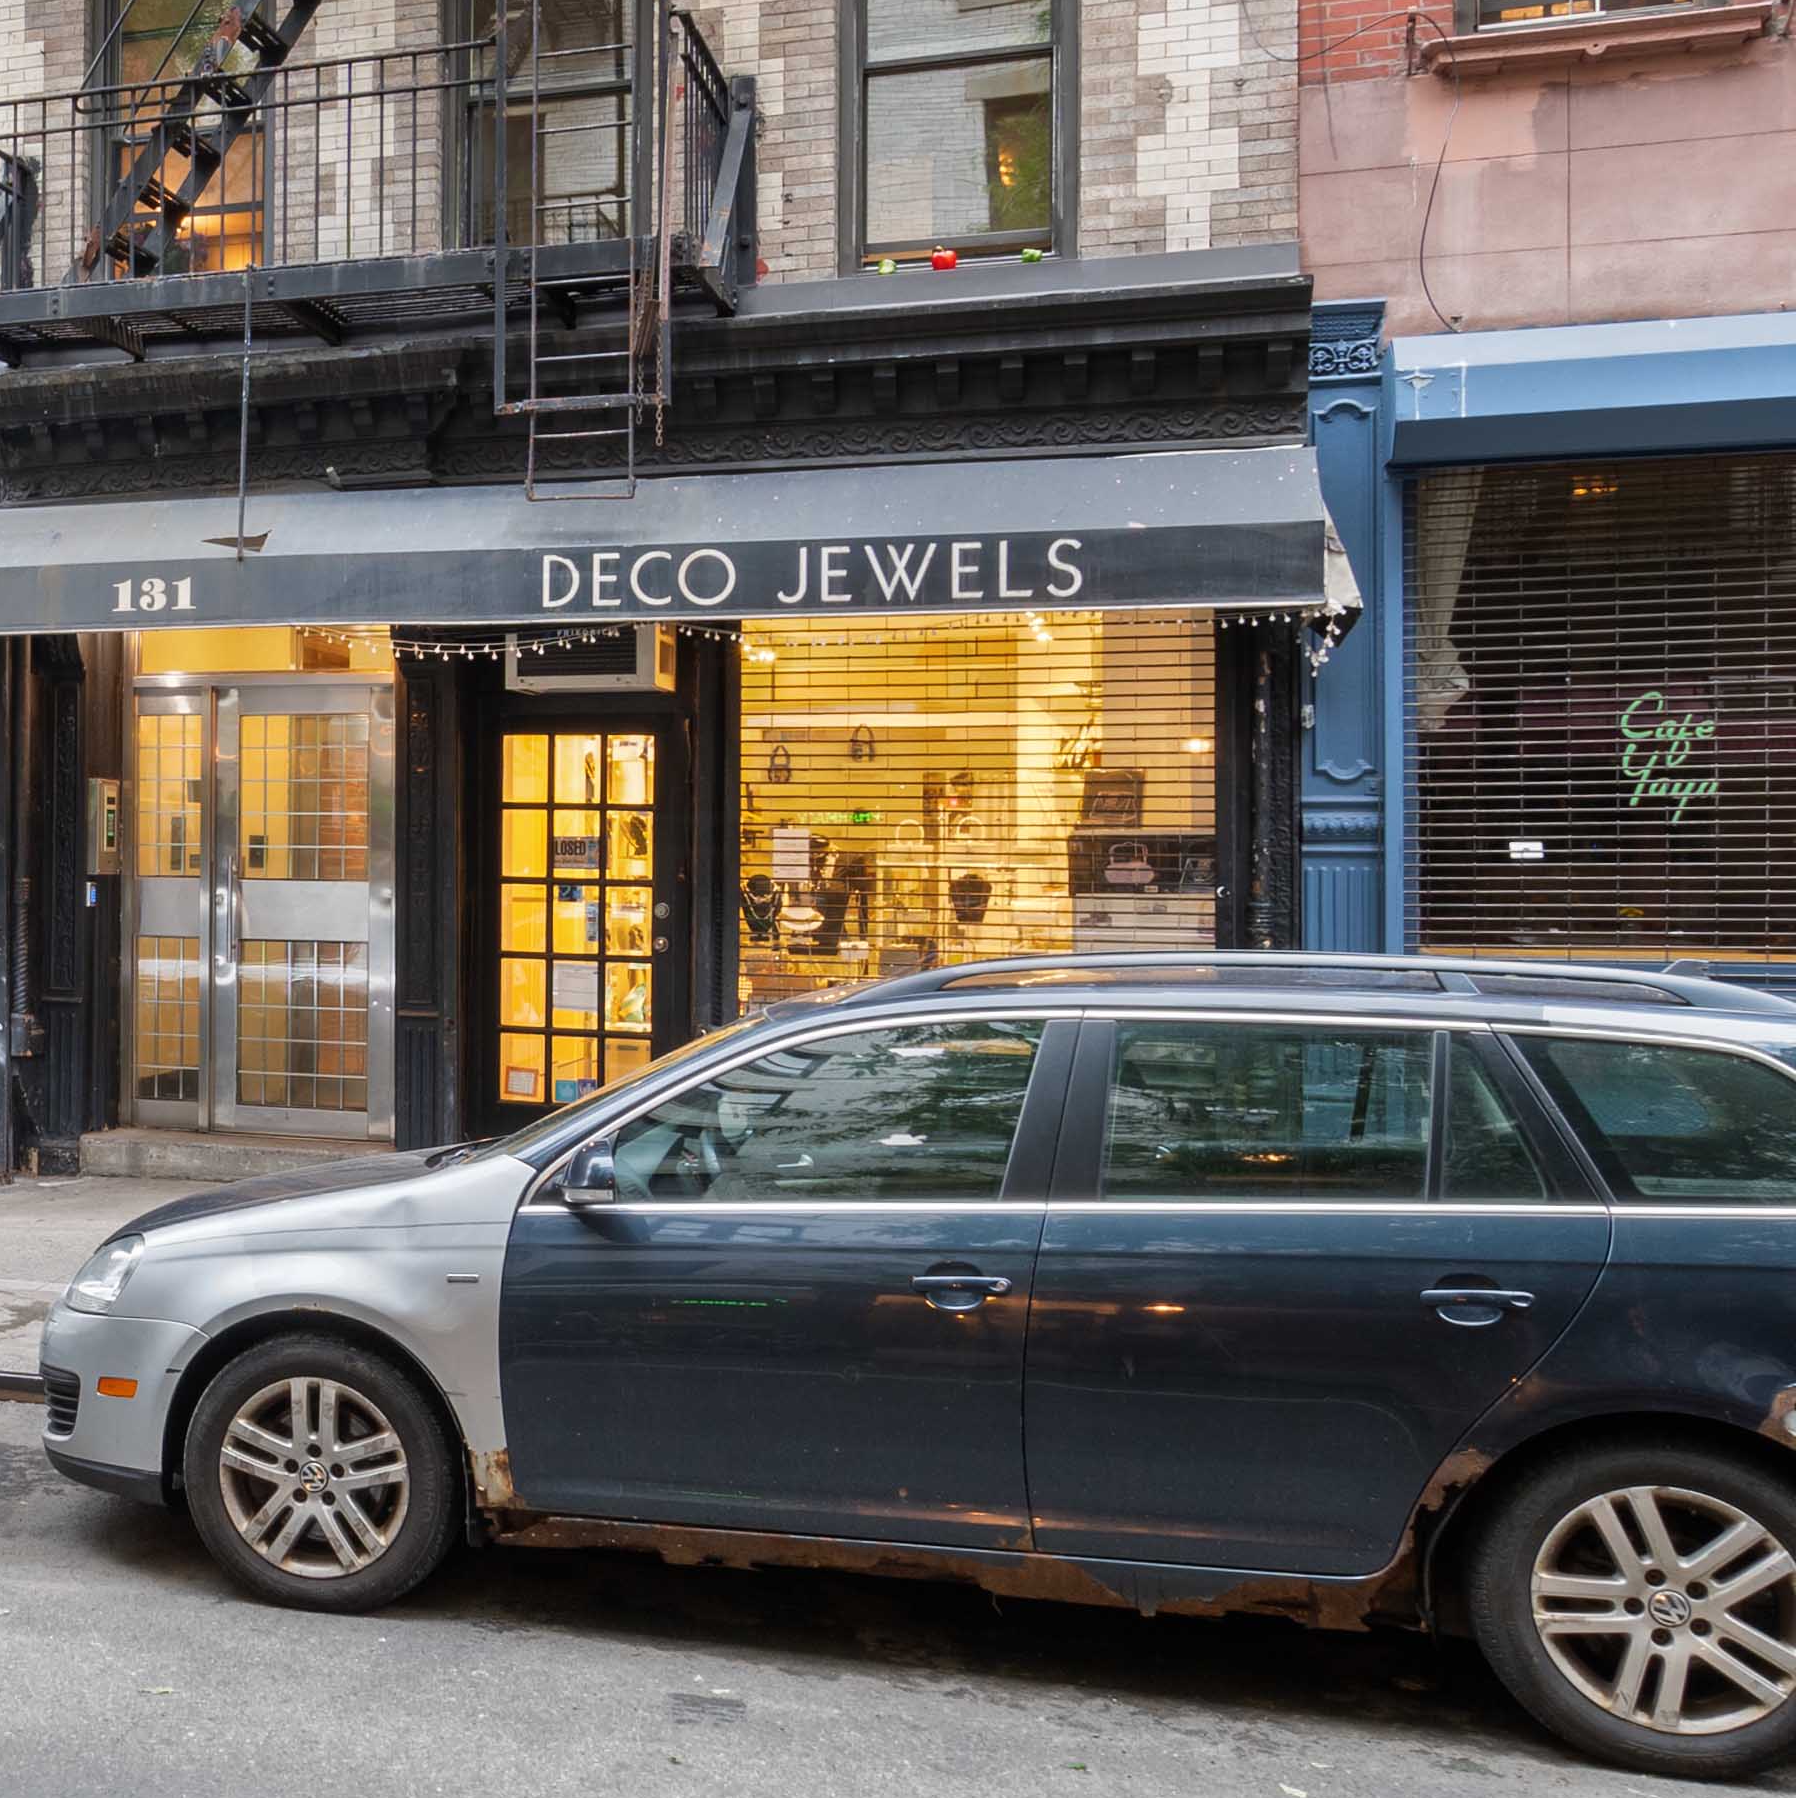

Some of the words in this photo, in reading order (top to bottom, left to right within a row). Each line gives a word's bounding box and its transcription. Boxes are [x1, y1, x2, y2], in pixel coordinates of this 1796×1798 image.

[541, 548, 737, 609] DECO
[776, 538, 1084, 605] JEWELS
[111, 576, 198, 612] 131
[554, 839, 587, 856] LOSED
